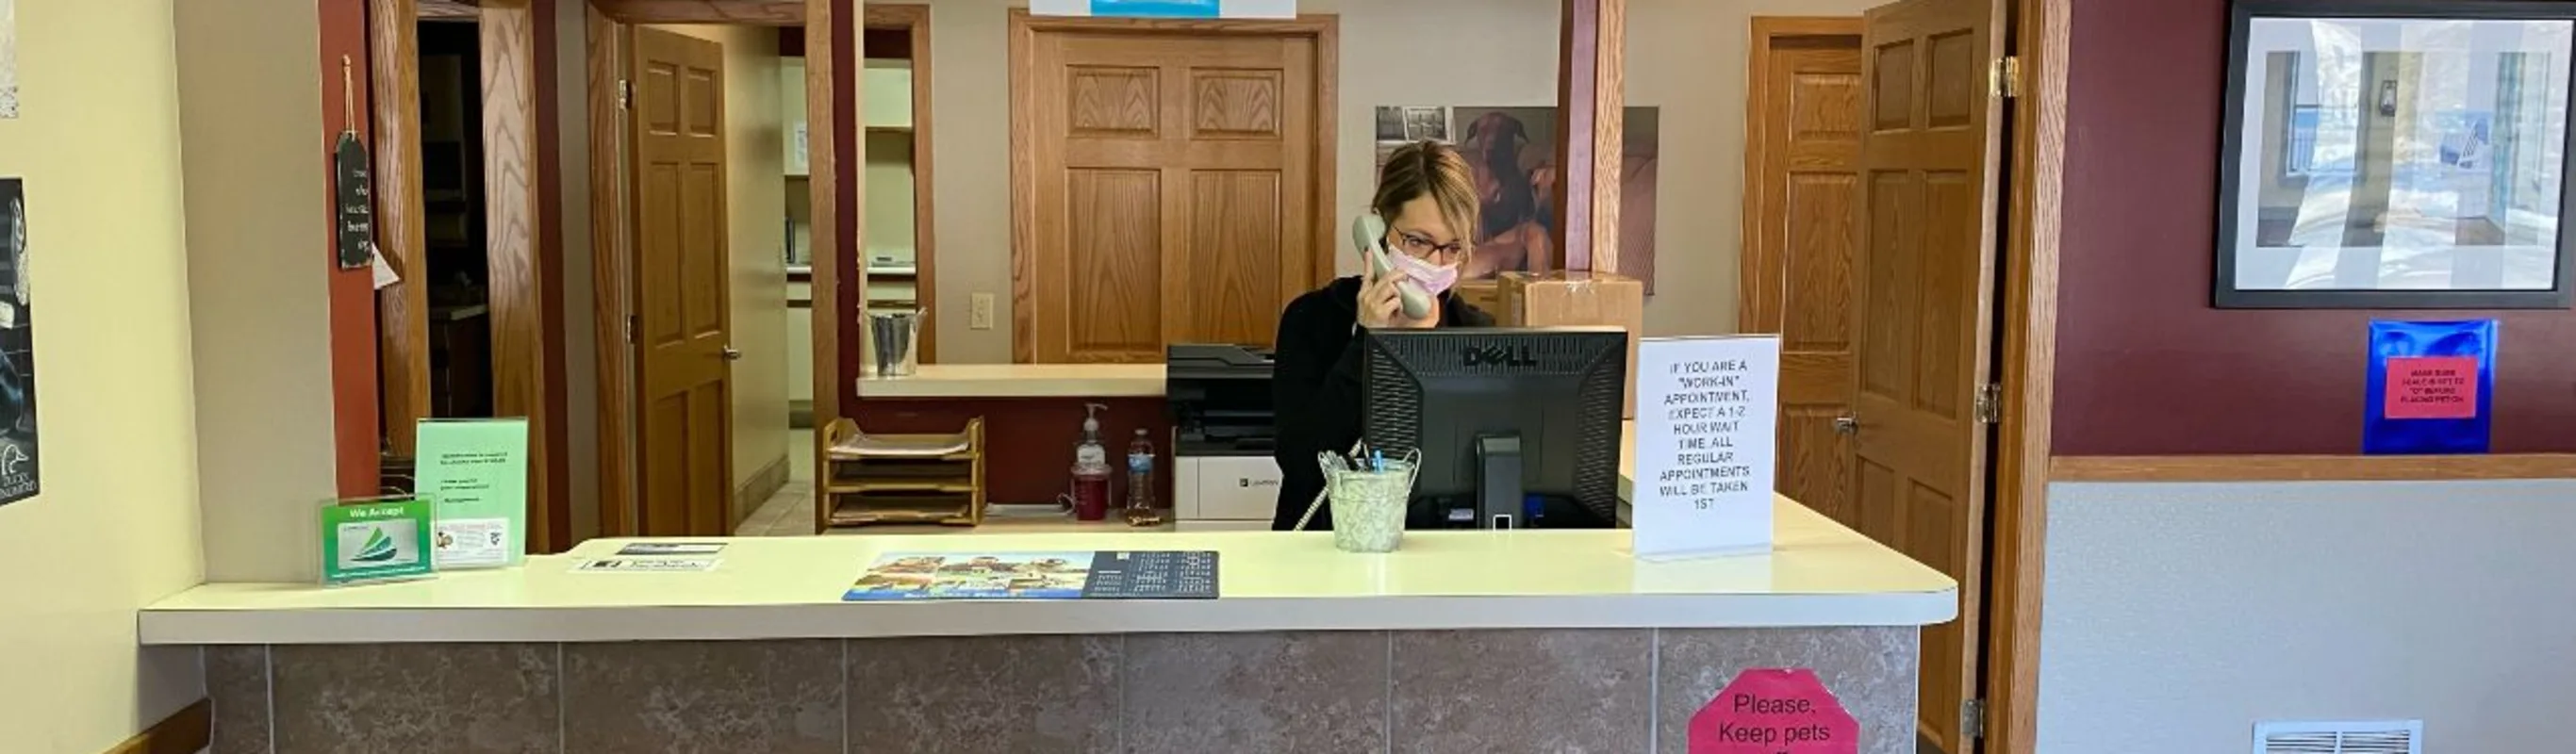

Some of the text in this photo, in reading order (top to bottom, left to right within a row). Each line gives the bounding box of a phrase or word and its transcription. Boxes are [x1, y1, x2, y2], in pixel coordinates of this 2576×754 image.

[1463, 346, 1536, 366] DELL
[1670, 359, 1747, 373] IF YOU ARE A
[1668, 407, 1714, 420] EXPECT
[1718, 406, 1726, 417] A
[1674, 421, 1739, 435] HOUR WAIT
[1678, 452, 1733, 465] REGULAR
[1660, 466, 1750, 482] APPOINTMENTS
[1660, 482, 1747, 497] WILL BE TAKEN
[1694, 499, 1714, 509] 1ST
[350, 506, 405, 517] We Accept
[1720, 722, 1830, 746] Keep pets
